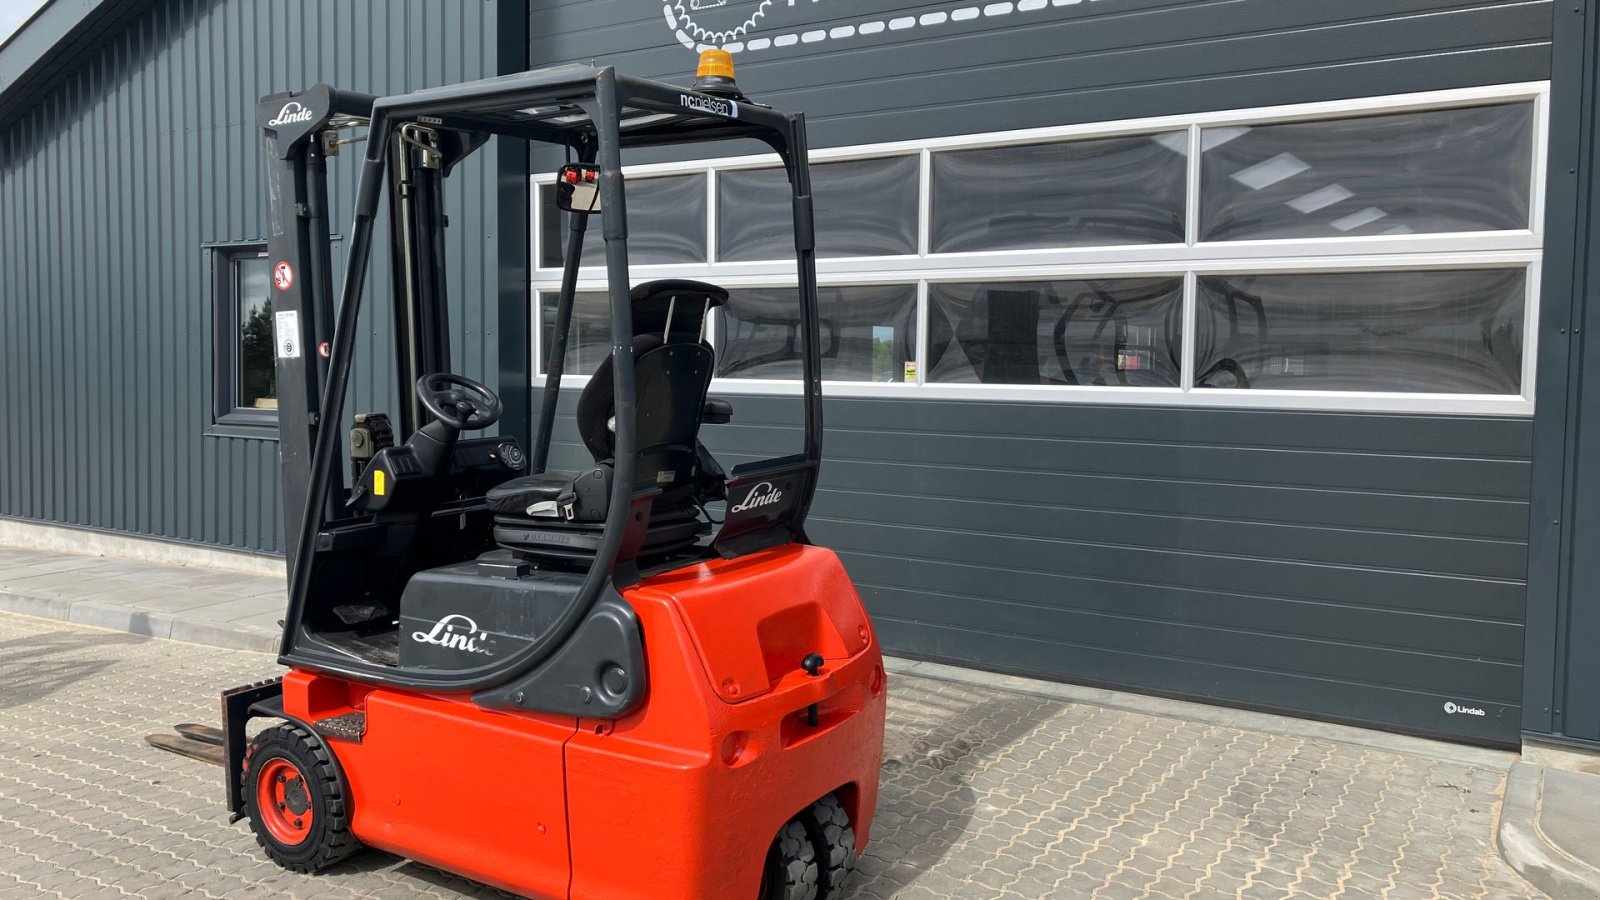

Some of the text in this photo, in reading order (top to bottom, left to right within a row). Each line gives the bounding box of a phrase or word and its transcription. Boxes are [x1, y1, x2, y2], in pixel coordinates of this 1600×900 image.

[268, 101, 313, 127] Linde
[681, 94, 728, 116] ncnielsen
[731, 482, 782, 513] Linde
[1457, 705, 1485, 716] Lindab
